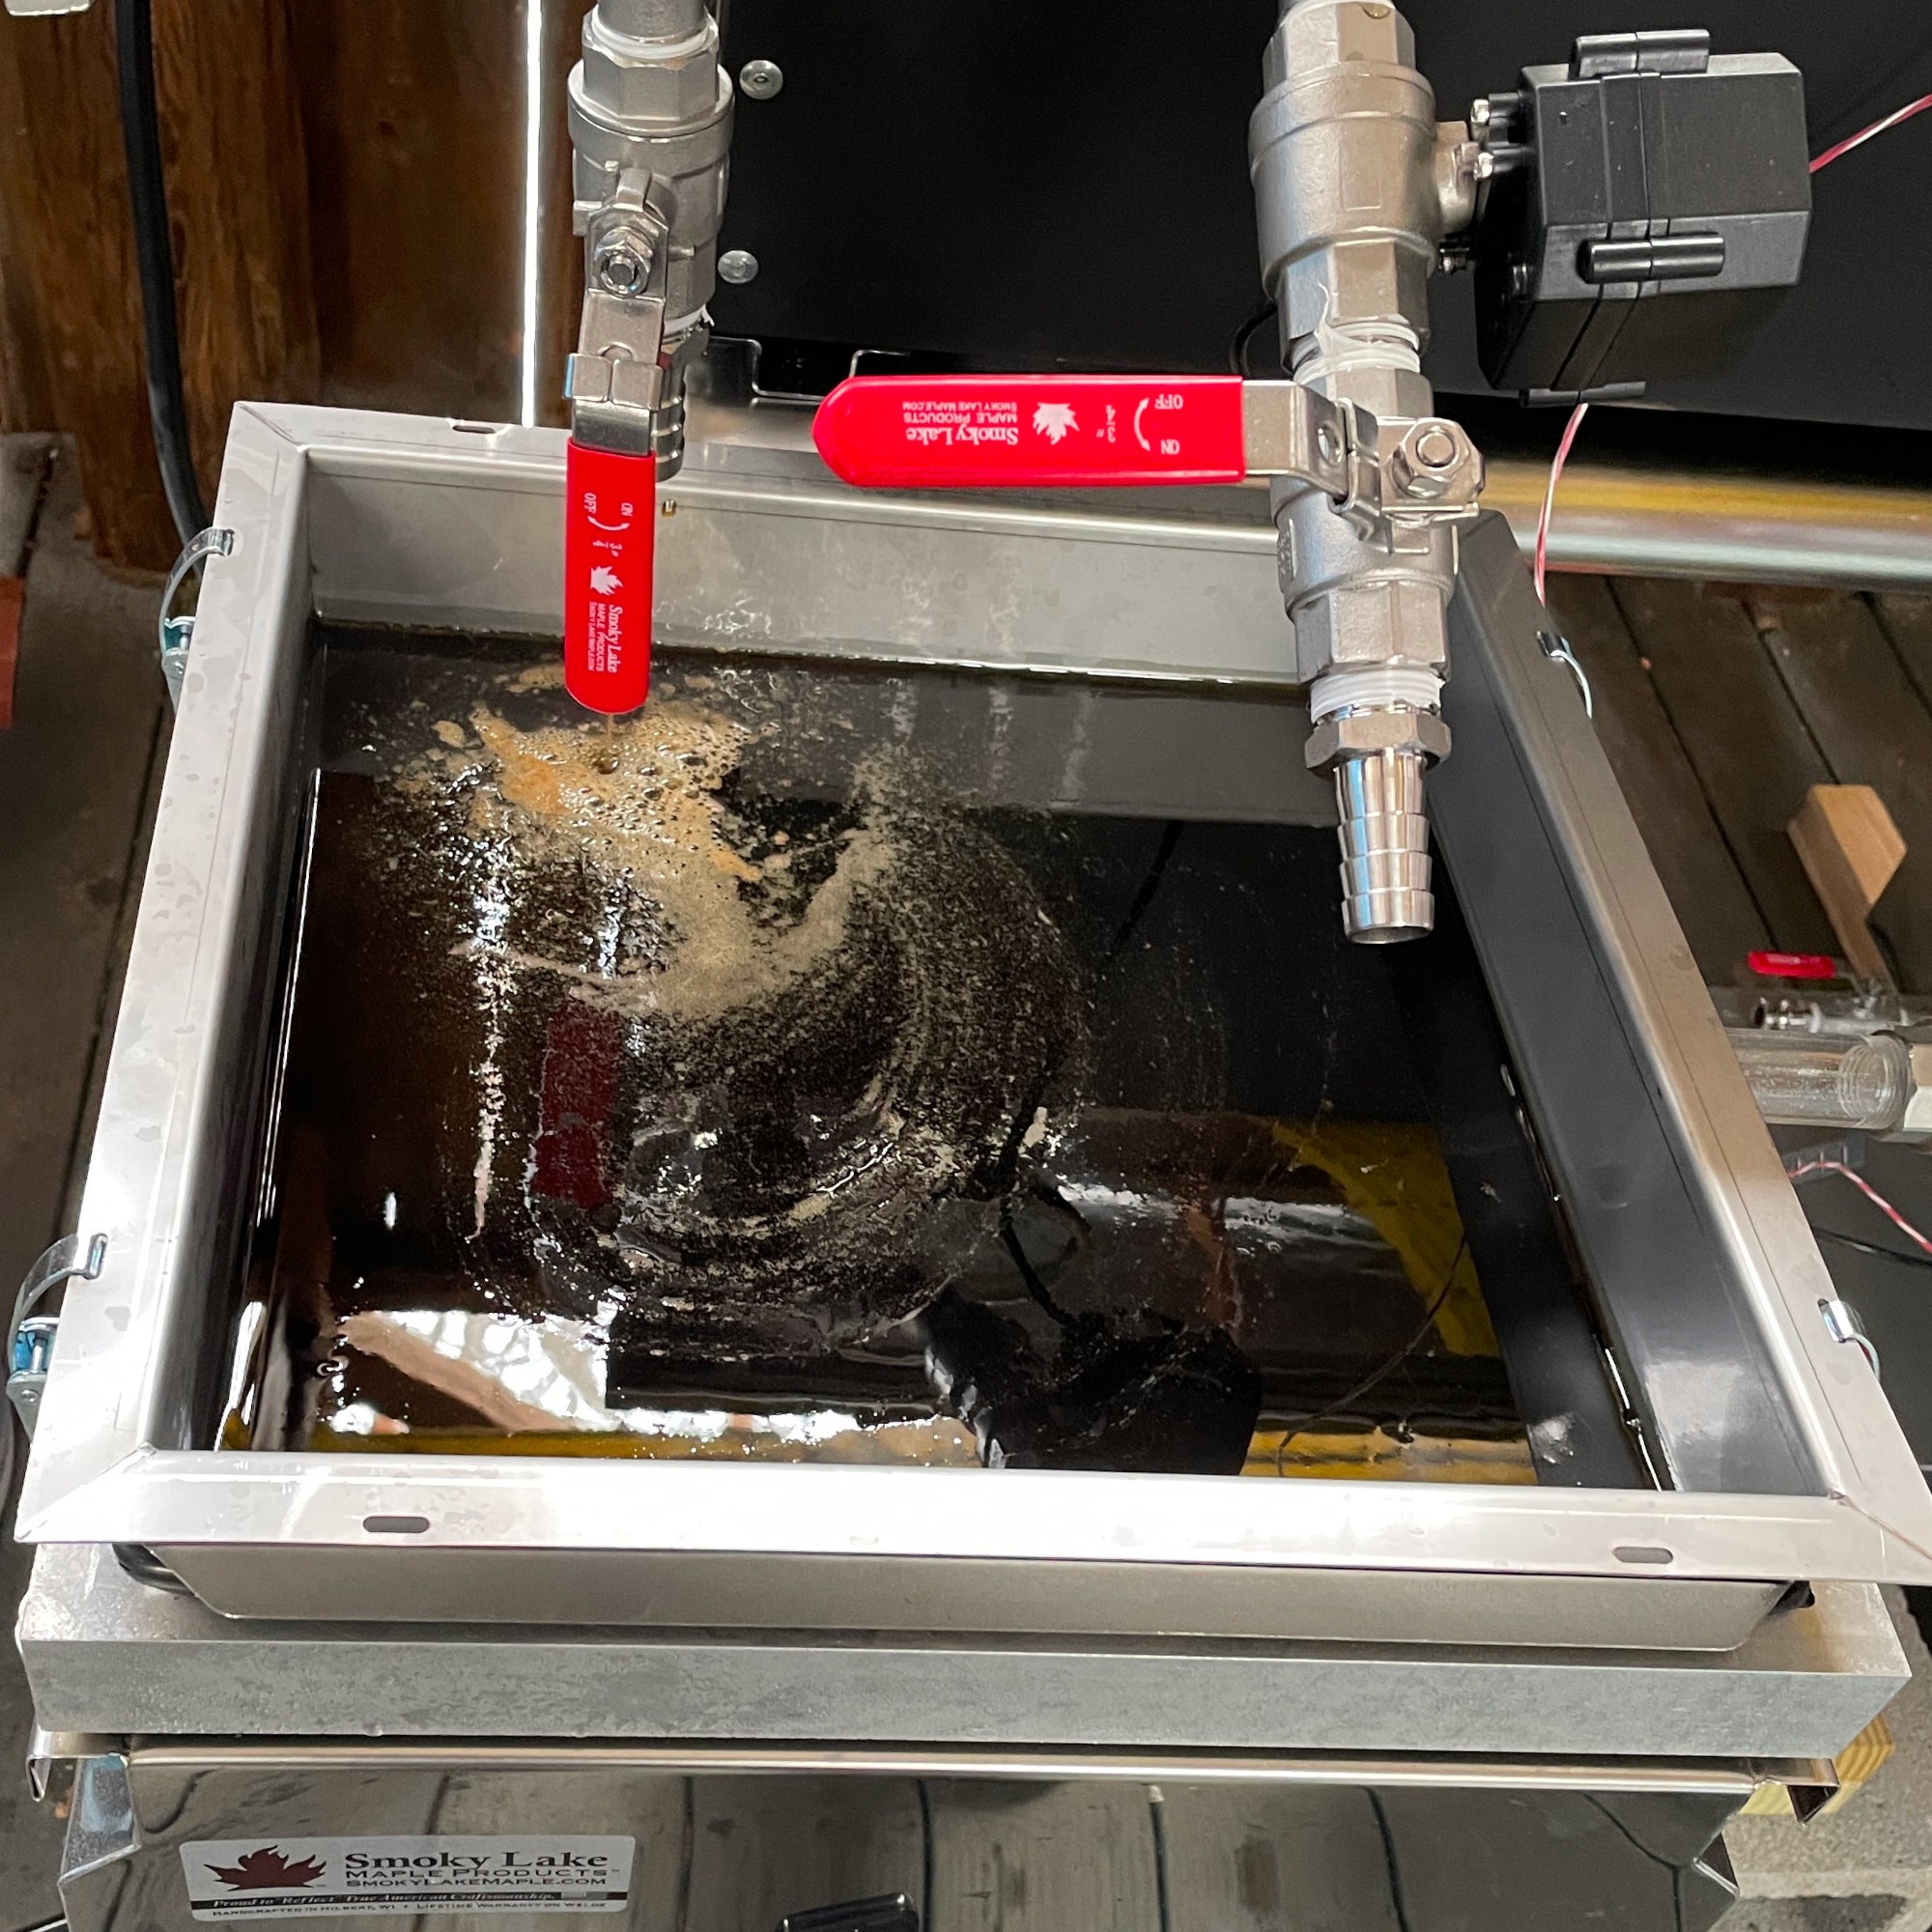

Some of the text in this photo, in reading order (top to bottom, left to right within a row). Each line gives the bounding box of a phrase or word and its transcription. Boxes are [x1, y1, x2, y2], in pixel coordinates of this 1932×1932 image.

[1154, 393, 1183, 410] OFF
[903, 412, 1017, 424] MAPLE PRODUCTS
[906, 423, 1018, 445] Smoky Lake
[1160, 439, 1180, 455] ON
[583, 492, 597, 514] OFF
[621, 502, 633, 517] ON
[596, 603, 606, 672] MAPLE PRODUCTS
[605, 604, 623, 673] Smoky Lake
[345, 1852, 609, 1870] Smoky Lake
[346, 1870, 443, 1879] MAPLE
[346, 1878, 607, 1888] SMOKYLAKEMAPLE.COM
[213, 1898, 257, 1908] Proud
